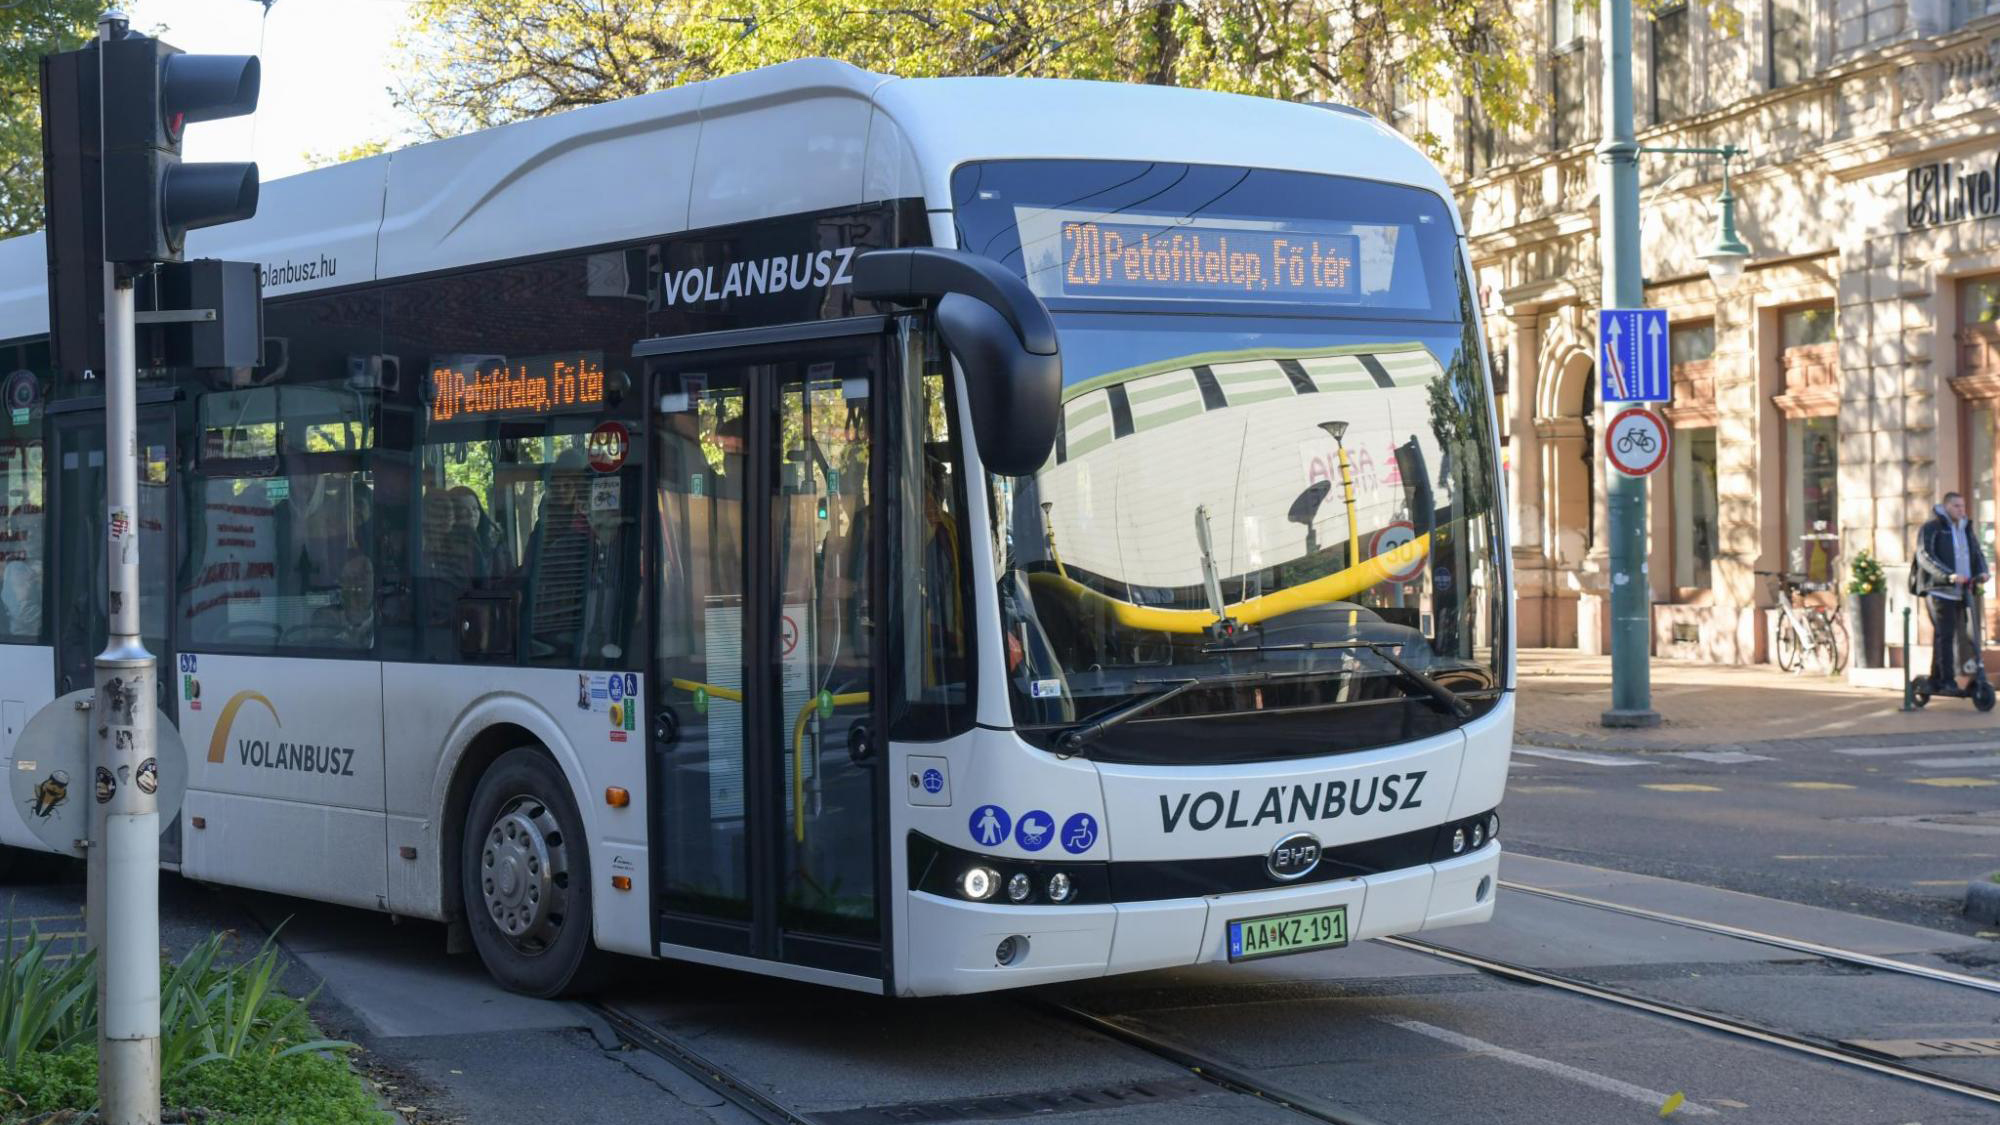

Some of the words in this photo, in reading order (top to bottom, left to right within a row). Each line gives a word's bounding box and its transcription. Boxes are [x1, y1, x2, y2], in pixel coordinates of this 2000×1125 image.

[261, 254, 336, 288] olanbusz.hu
[664, 246, 857, 306] VOLÁNBUSZ
[1064, 224, 1100, 285] 20
[1104, 231, 1268, 290] Petőfitelep,
[1273, 239, 1304, 286] Fő
[1311, 241, 1351, 288] tér
[433, 369, 452, 420] 20
[455, 366, 551, 412] Petőfitelep,
[554, 362, 575, 404] Fő
[578, 359, 604, 402] tér
[239, 738, 355, 777] VOLÁNBUSZ
[1159, 770, 1428, 834] VOLÁNBUSZ
[1275, 845, 1317, 868] BYD
[1245, 926, 1270, 951] AA
[1279, 913, 1343, 946] KZ-191
